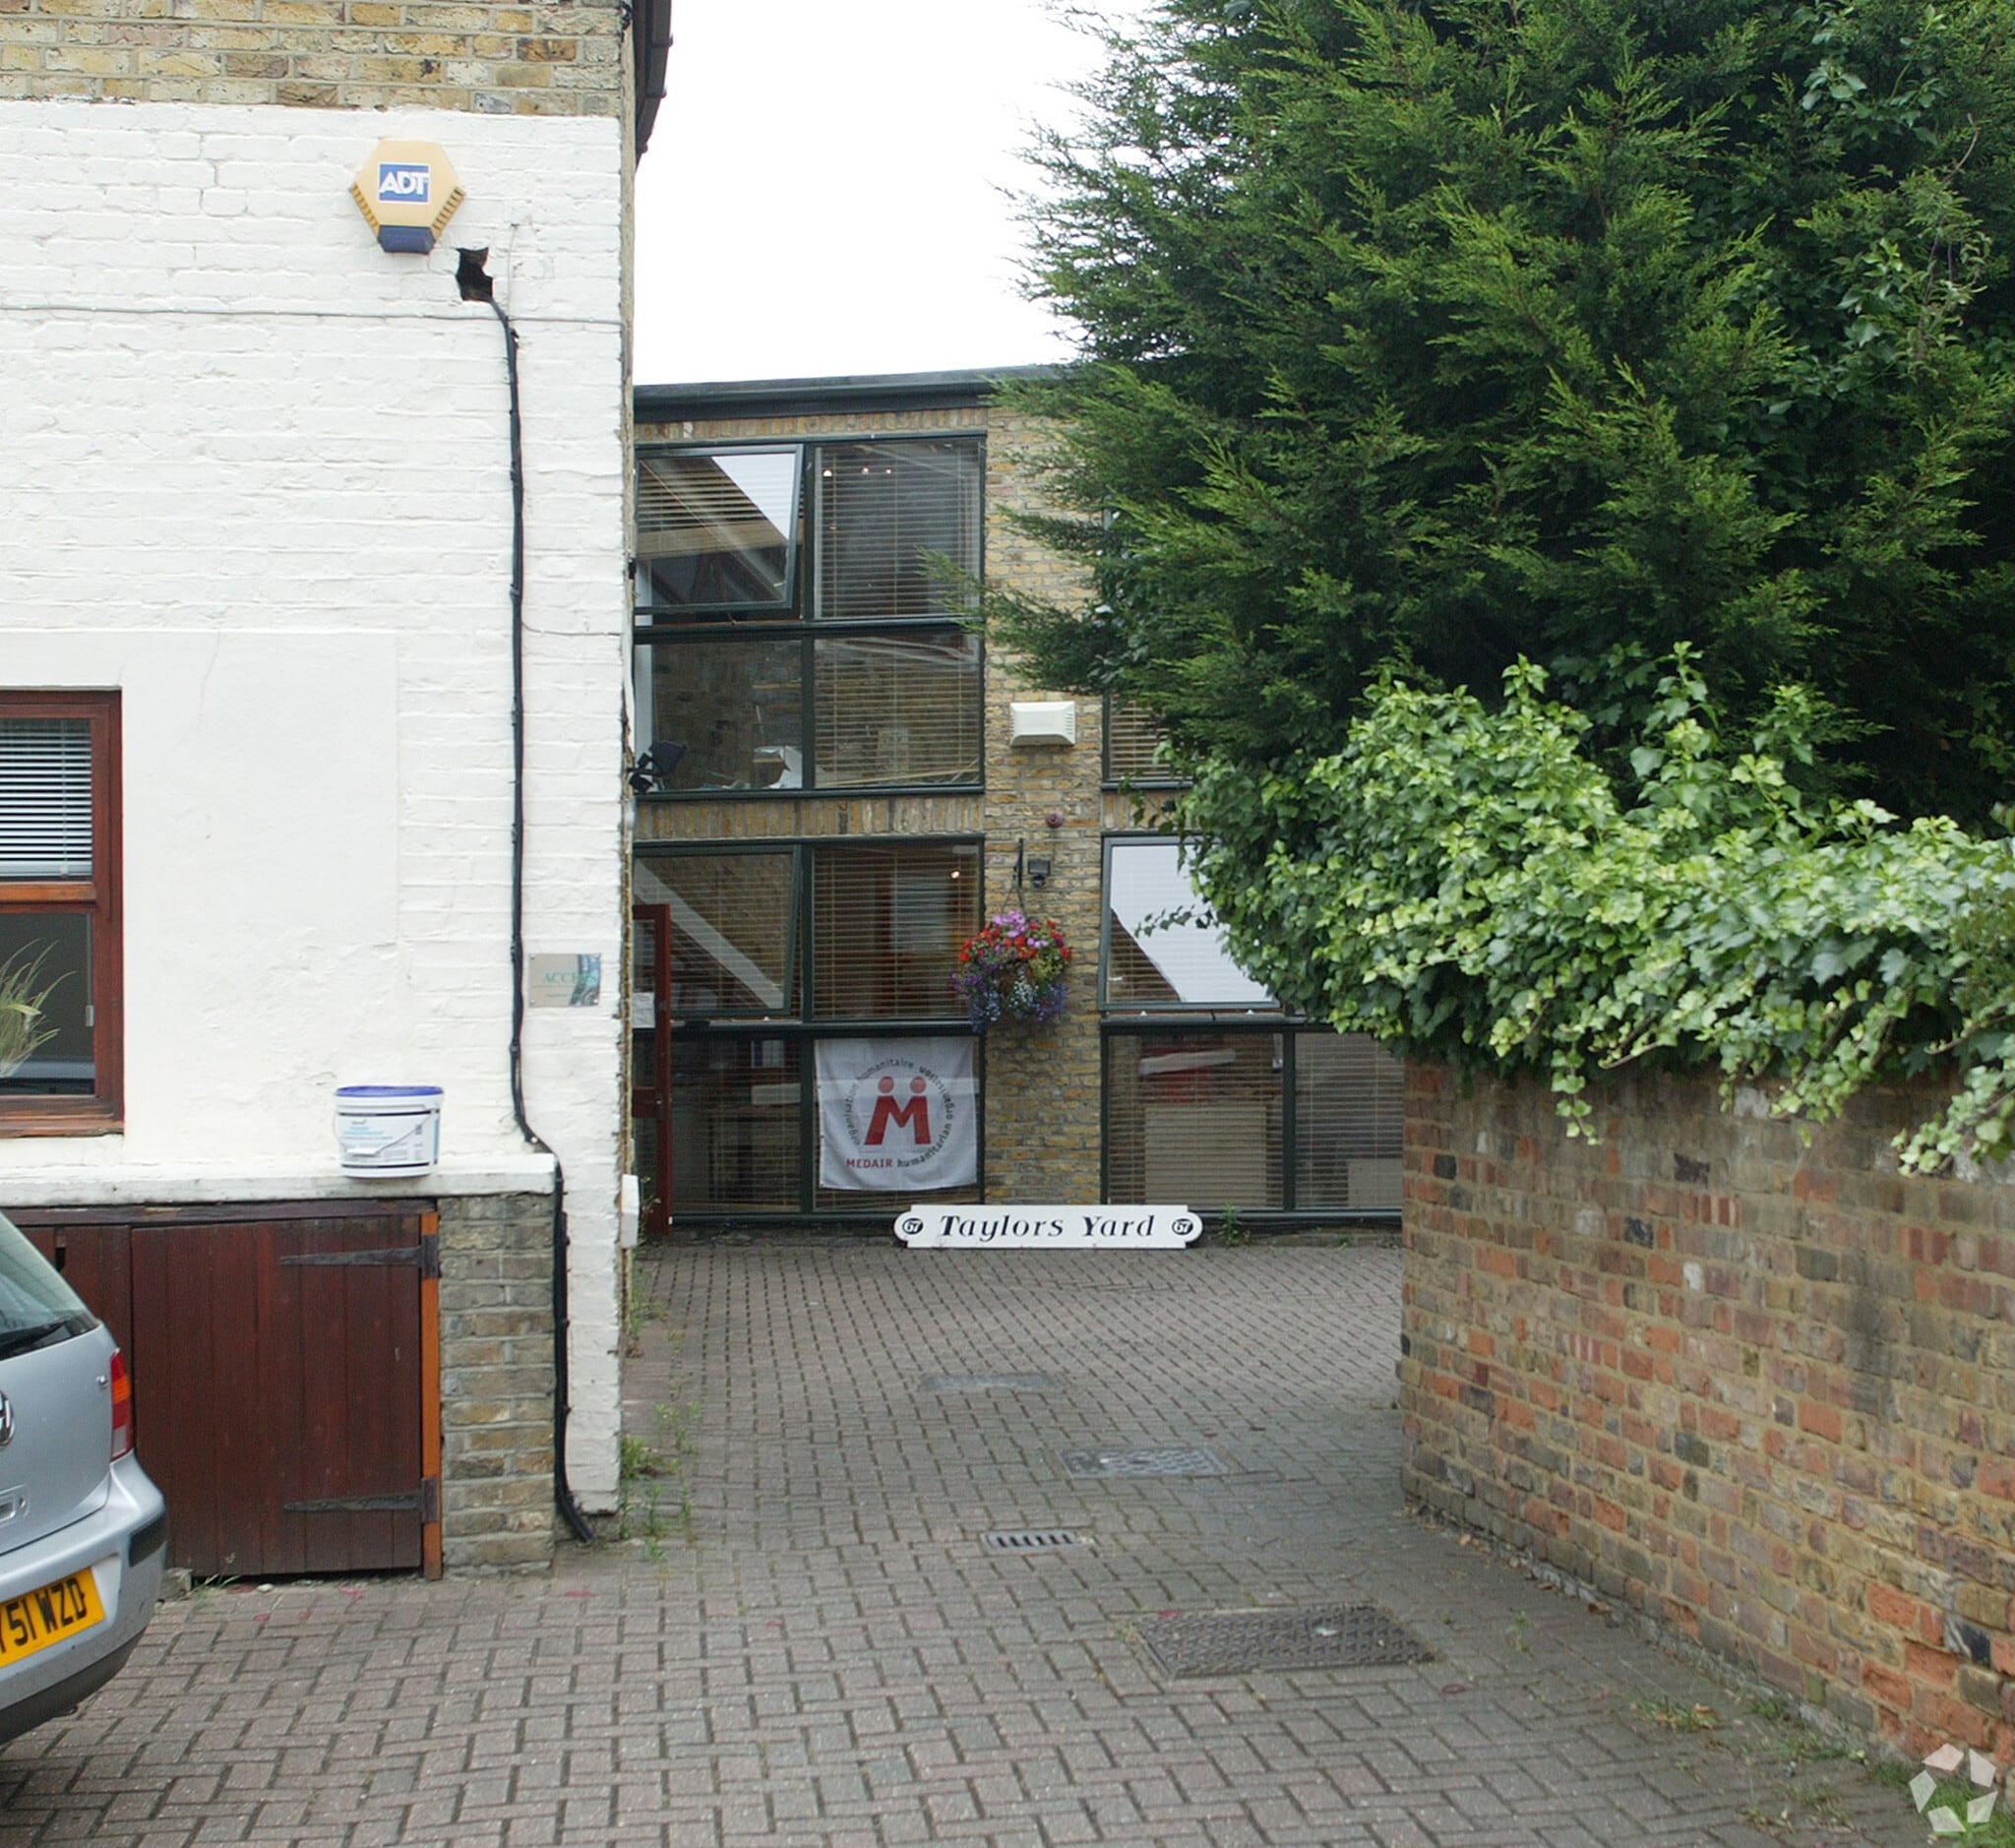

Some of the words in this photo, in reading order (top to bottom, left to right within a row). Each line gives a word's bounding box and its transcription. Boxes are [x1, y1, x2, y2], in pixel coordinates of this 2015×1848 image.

[380, 170, 430, 195] ADT
[845, 1158, 893, 1169] MEDAIR
[897, 1123, 952, 1168] humanitarian
[904, 1220, 923, 1233] 67
[941, 1214, 1064, 1242] Taylors
[1082, 1214, 1154, 1237] Yard
[1174, 1220, 1192, 1233] 67
[32, 1577, 87, 1634] WZD
